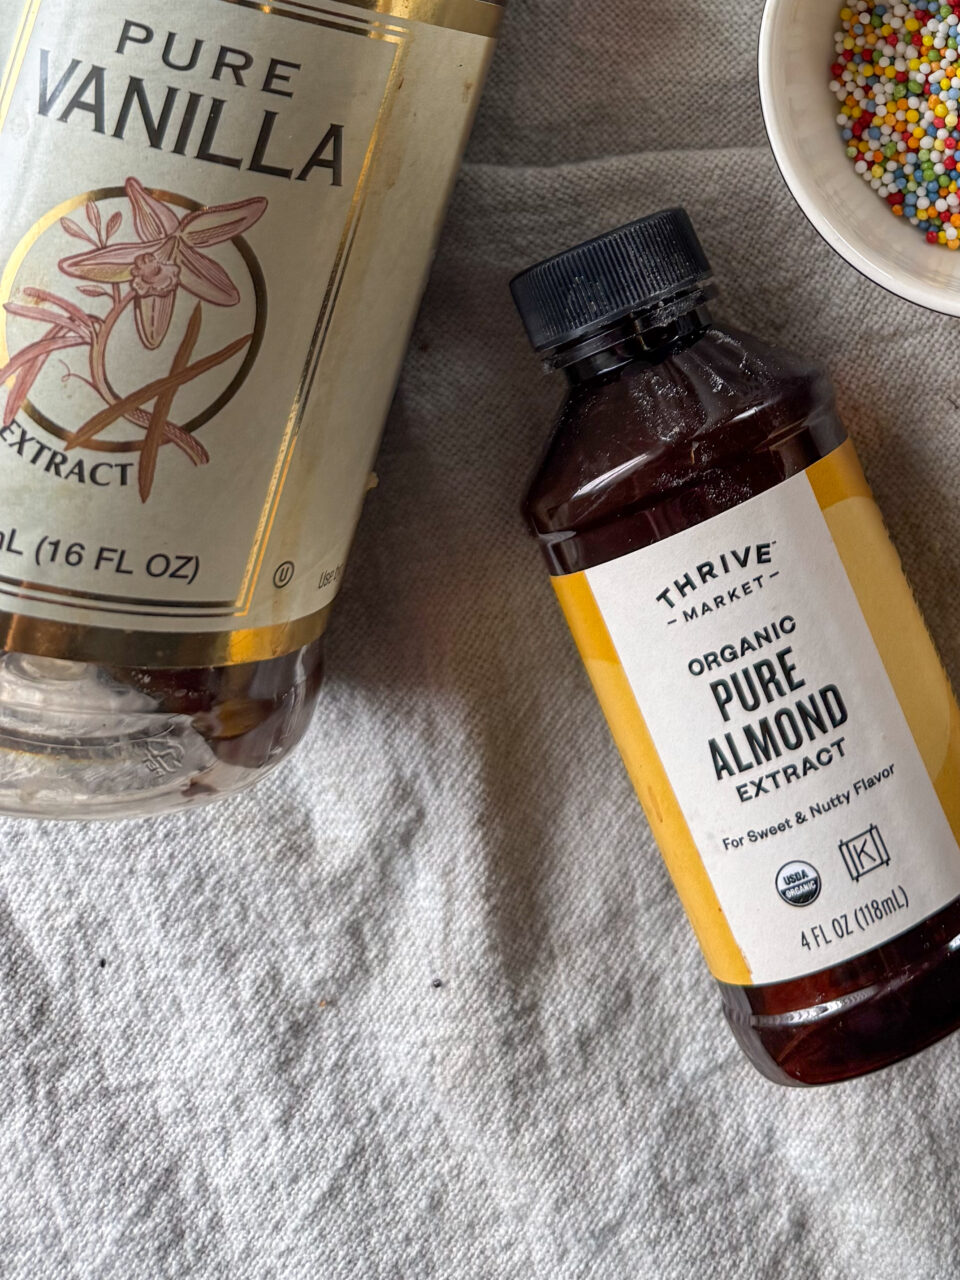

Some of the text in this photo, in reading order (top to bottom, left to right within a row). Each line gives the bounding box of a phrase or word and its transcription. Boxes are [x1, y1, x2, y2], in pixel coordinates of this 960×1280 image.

[115, 19, 302, 99] PURE
[37, 49, 345, 187] VANILLA
[0, 418, 134, 487] EXTRACT
[0, 528, 200, 585] L (16 FL OZ)
[656, 542, 772, 608] THRIVE
[682, 574, 764, 622] MARKET
[688, 615, 796, 676] ORGANIC
[709, 646, 806, 722] PURE
[708, 683, 848, 780] ALMOND
[735, 737, 846, 803] EXTRACT
[722, 763, 896, 850] For Sweet & Nutty Flavor
[783, 869, 809, 886] USDA
[852, 838, 876, 869] K
[785, 880, 817, 898] ORGANIC
[800, 885, 909, 951] 4 FL OZ (118mL)
